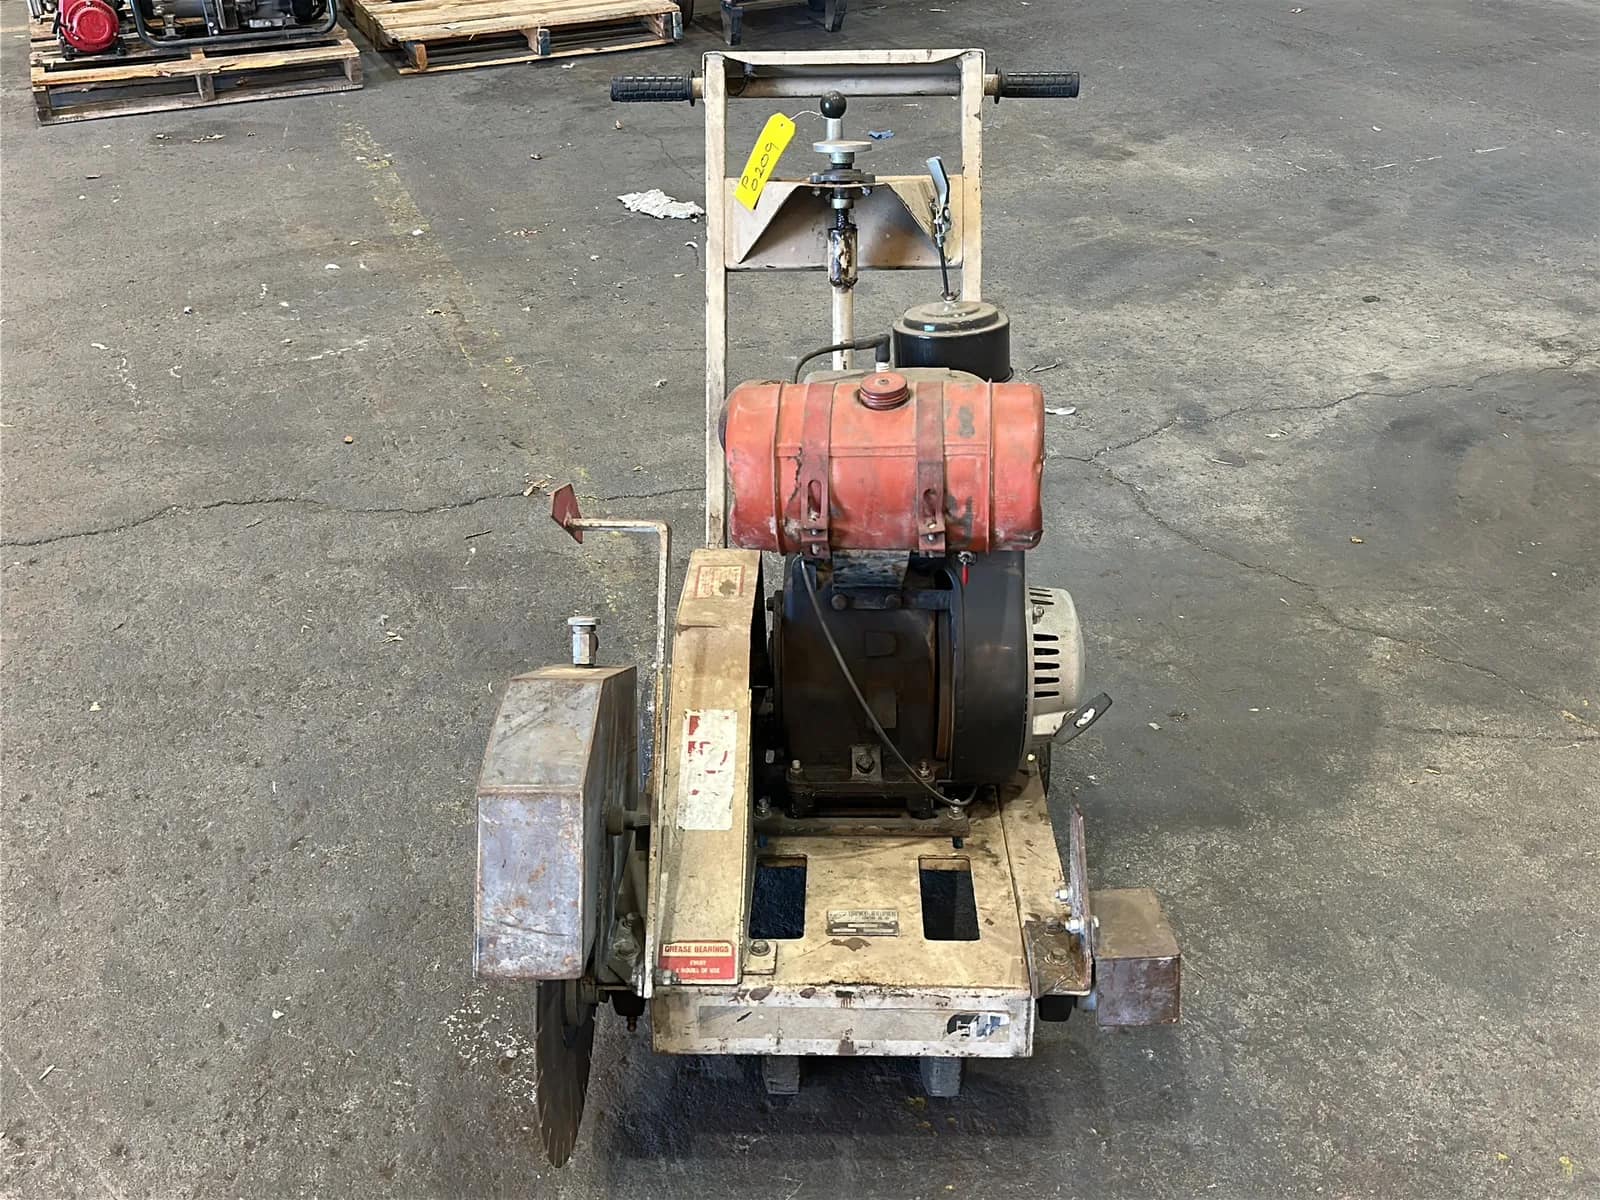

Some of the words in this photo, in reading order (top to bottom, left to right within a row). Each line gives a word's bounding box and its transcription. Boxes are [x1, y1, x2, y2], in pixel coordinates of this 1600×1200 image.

[741, 175, 749, 190] P
[664, 945, 692, 953] GREASE
[694, 945, 729, 953] BEARINGS
